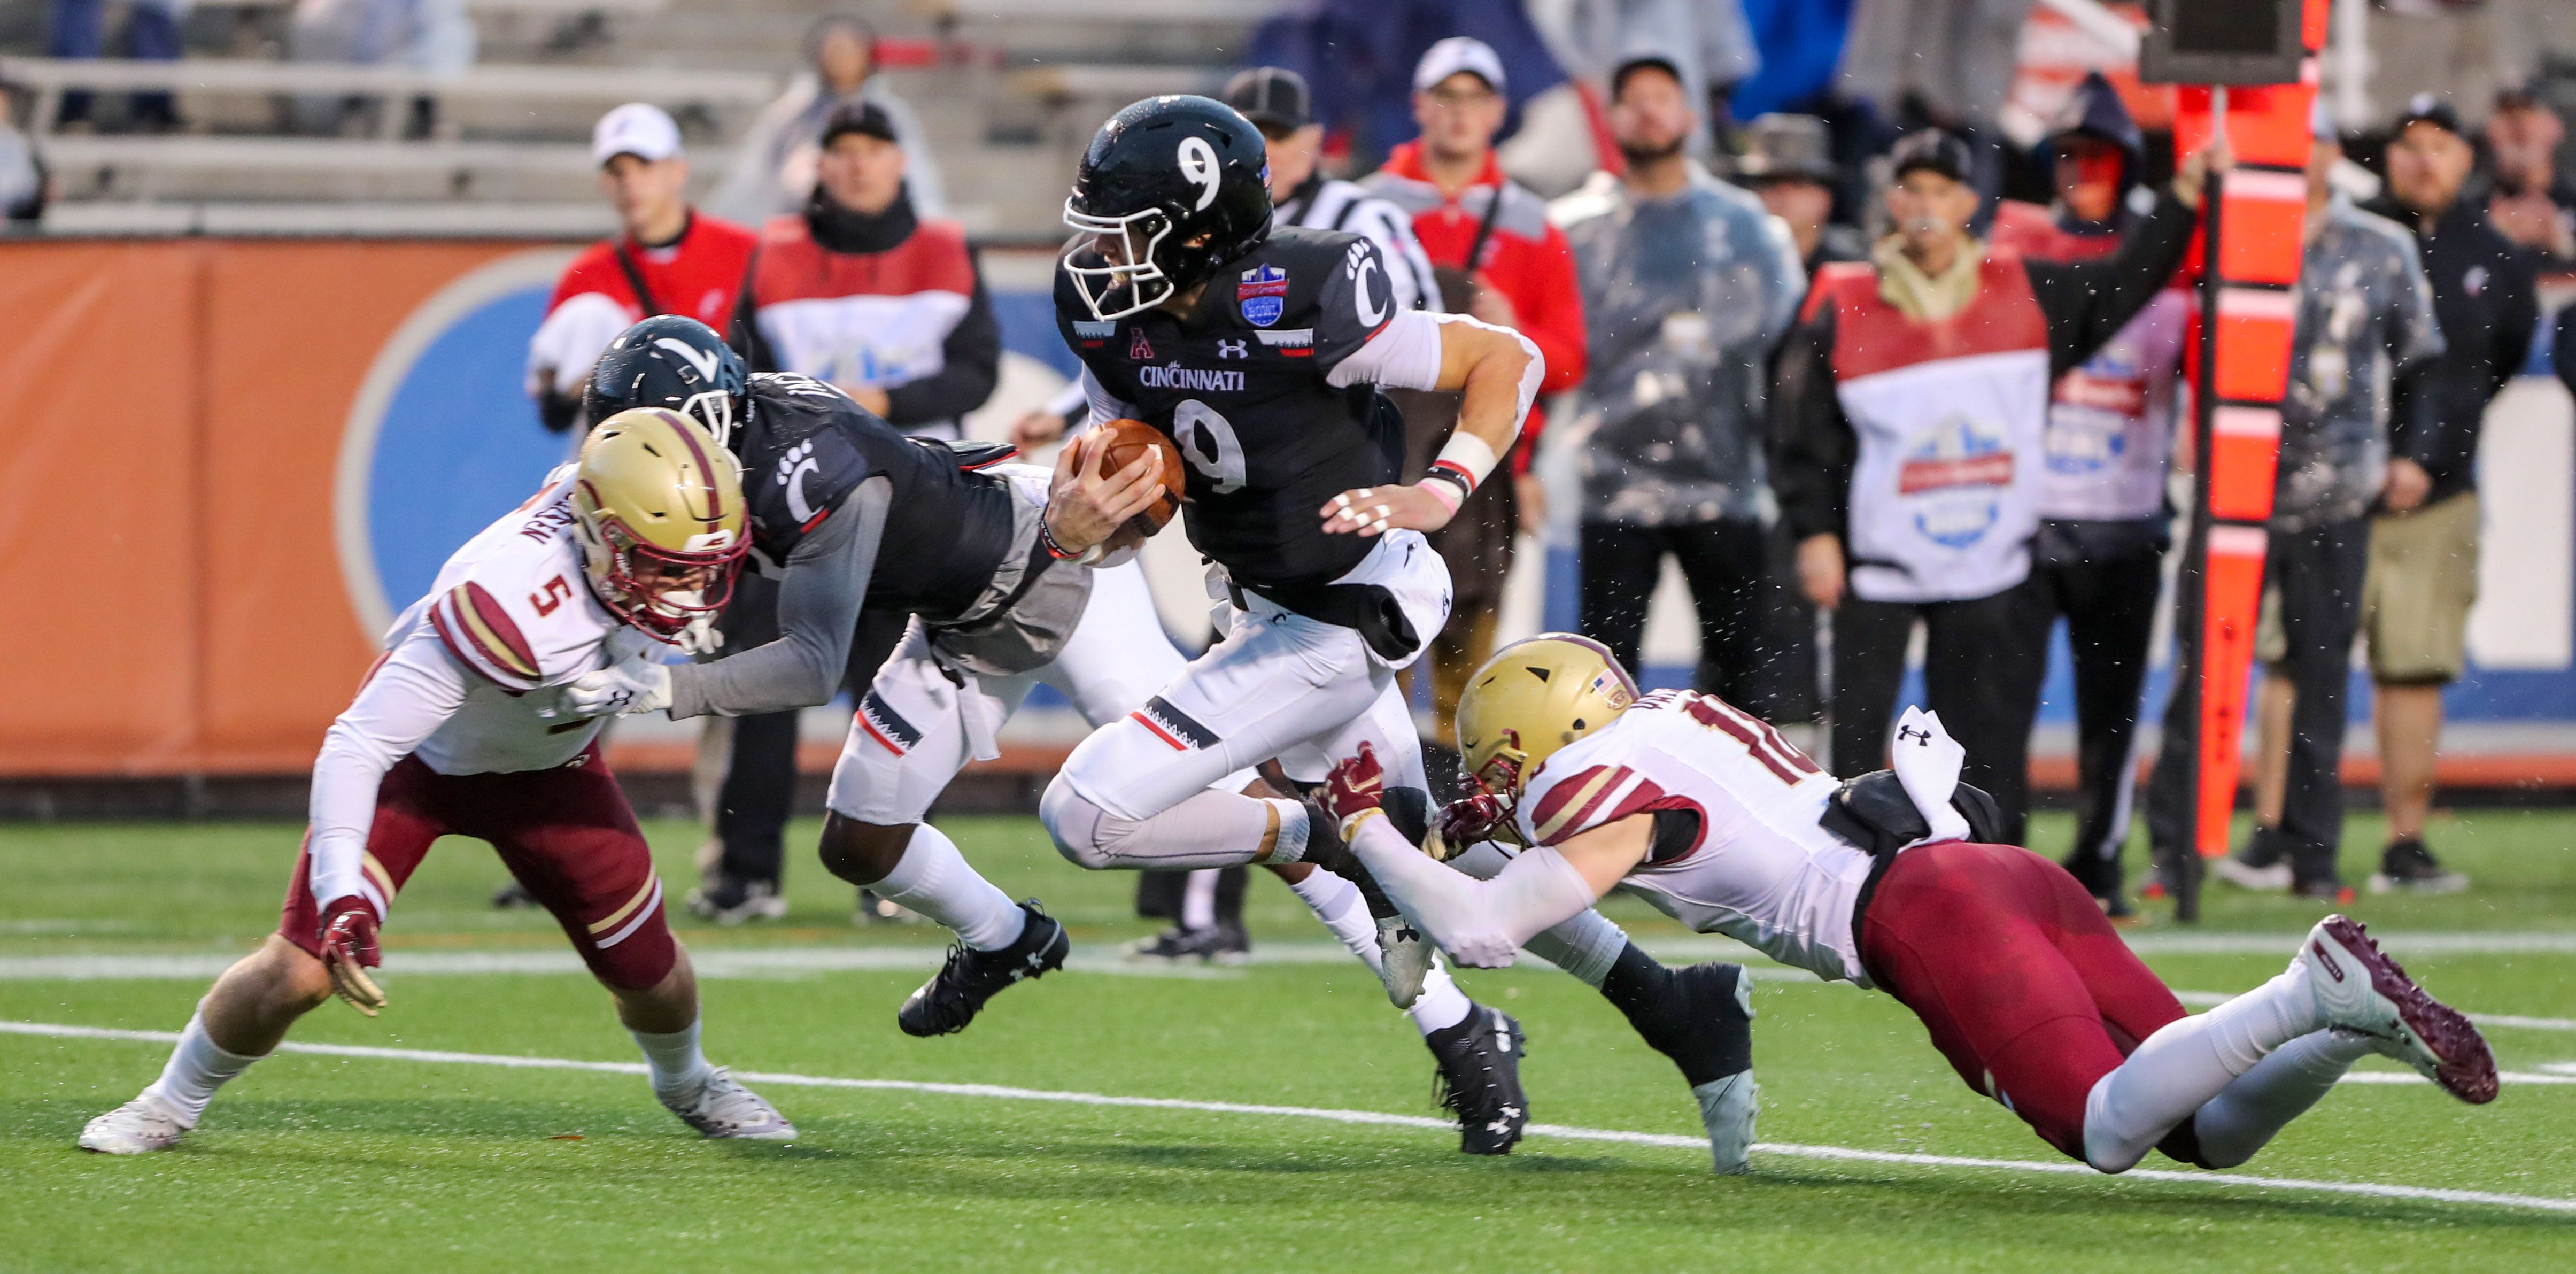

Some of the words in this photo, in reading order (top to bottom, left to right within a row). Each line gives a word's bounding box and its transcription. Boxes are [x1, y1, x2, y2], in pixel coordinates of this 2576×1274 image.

[1178, 136, 1221, 212] 9
[1139, 364, 1245, 391] CINCINNATI
[1174, 399, 1246, 494] 9
[529, 573, 571, 617] 5
